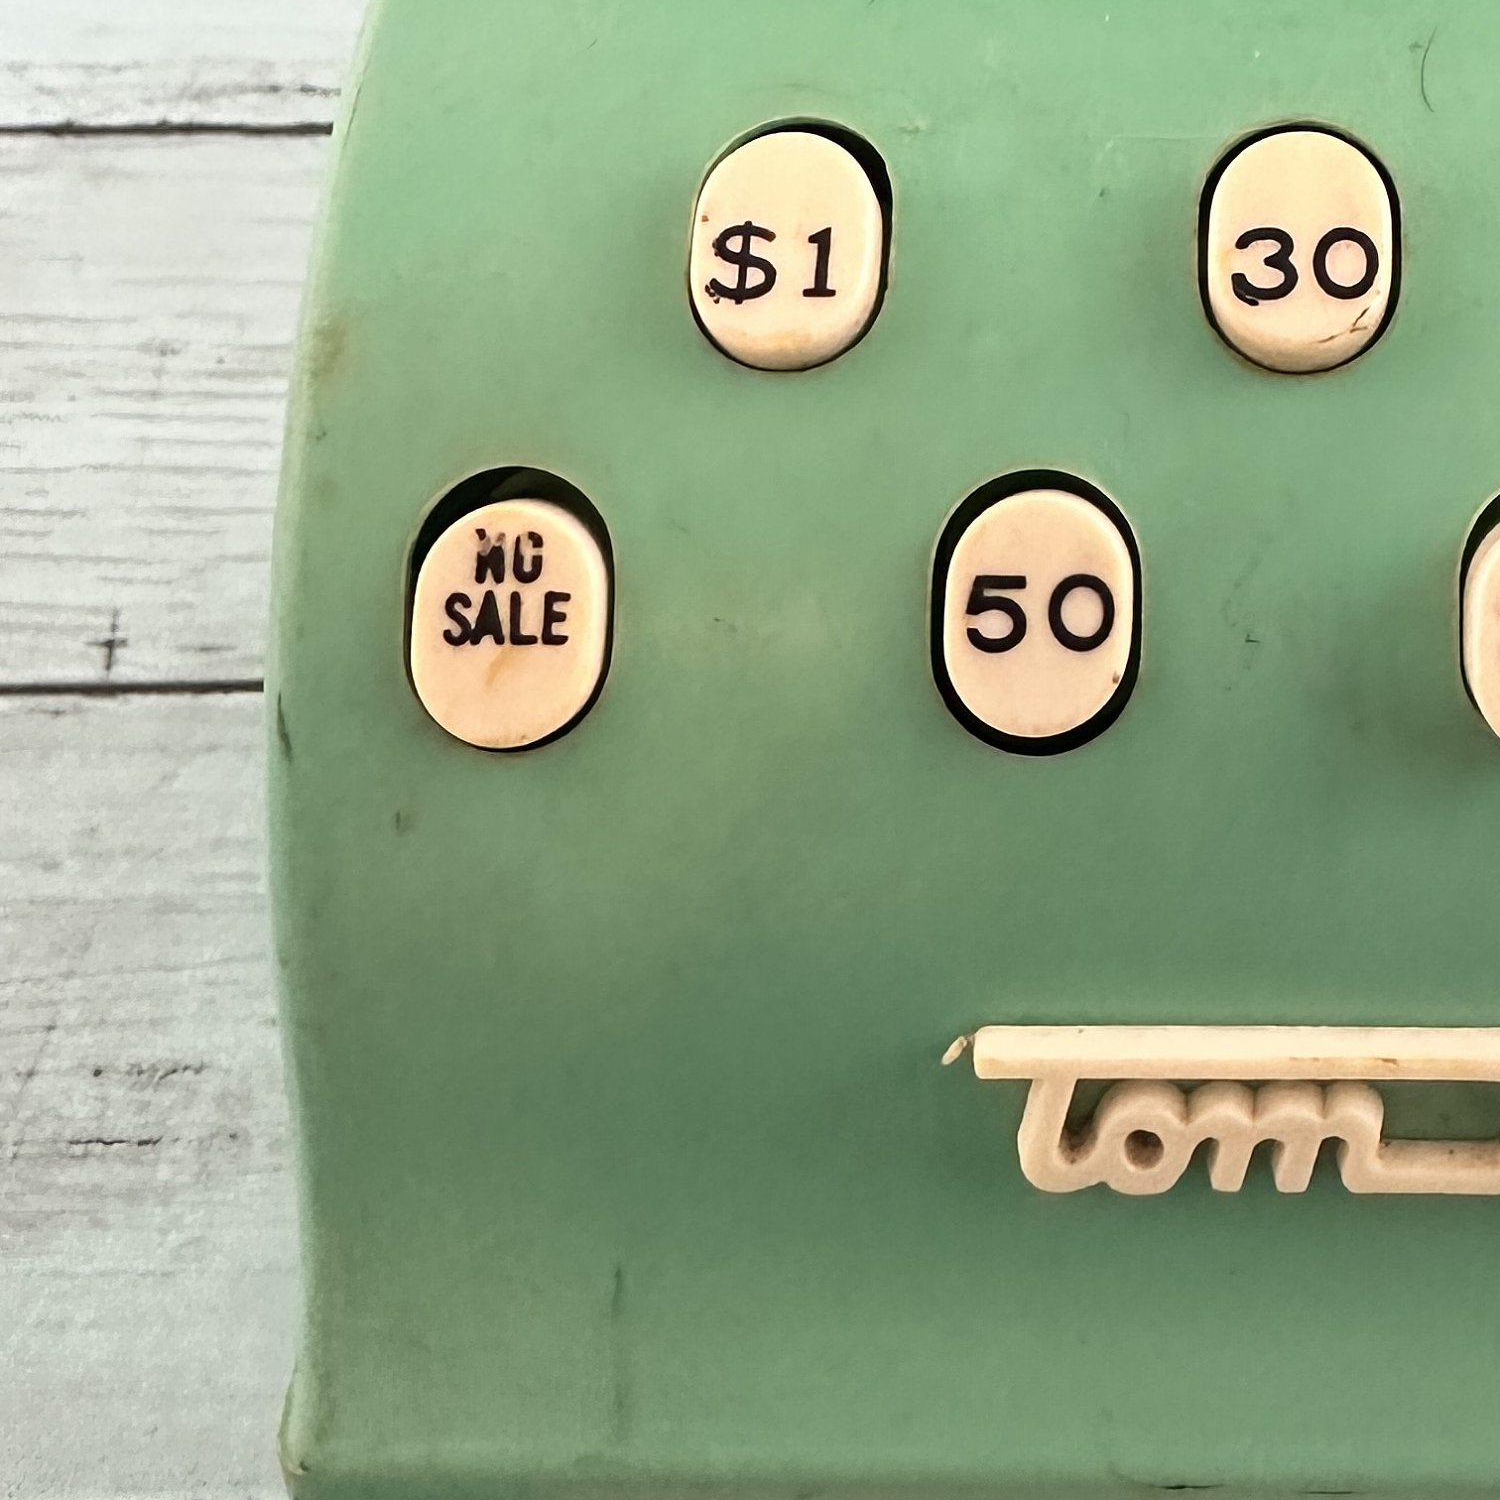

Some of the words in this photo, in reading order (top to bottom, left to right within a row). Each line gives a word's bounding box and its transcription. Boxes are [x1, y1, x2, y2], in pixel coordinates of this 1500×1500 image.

[706, 220, 837, 305] $1
[1230, 226, 1380, 307] 30
[442, 590, 571, 647] SALE
[965, 572, 1116, 654] 50
